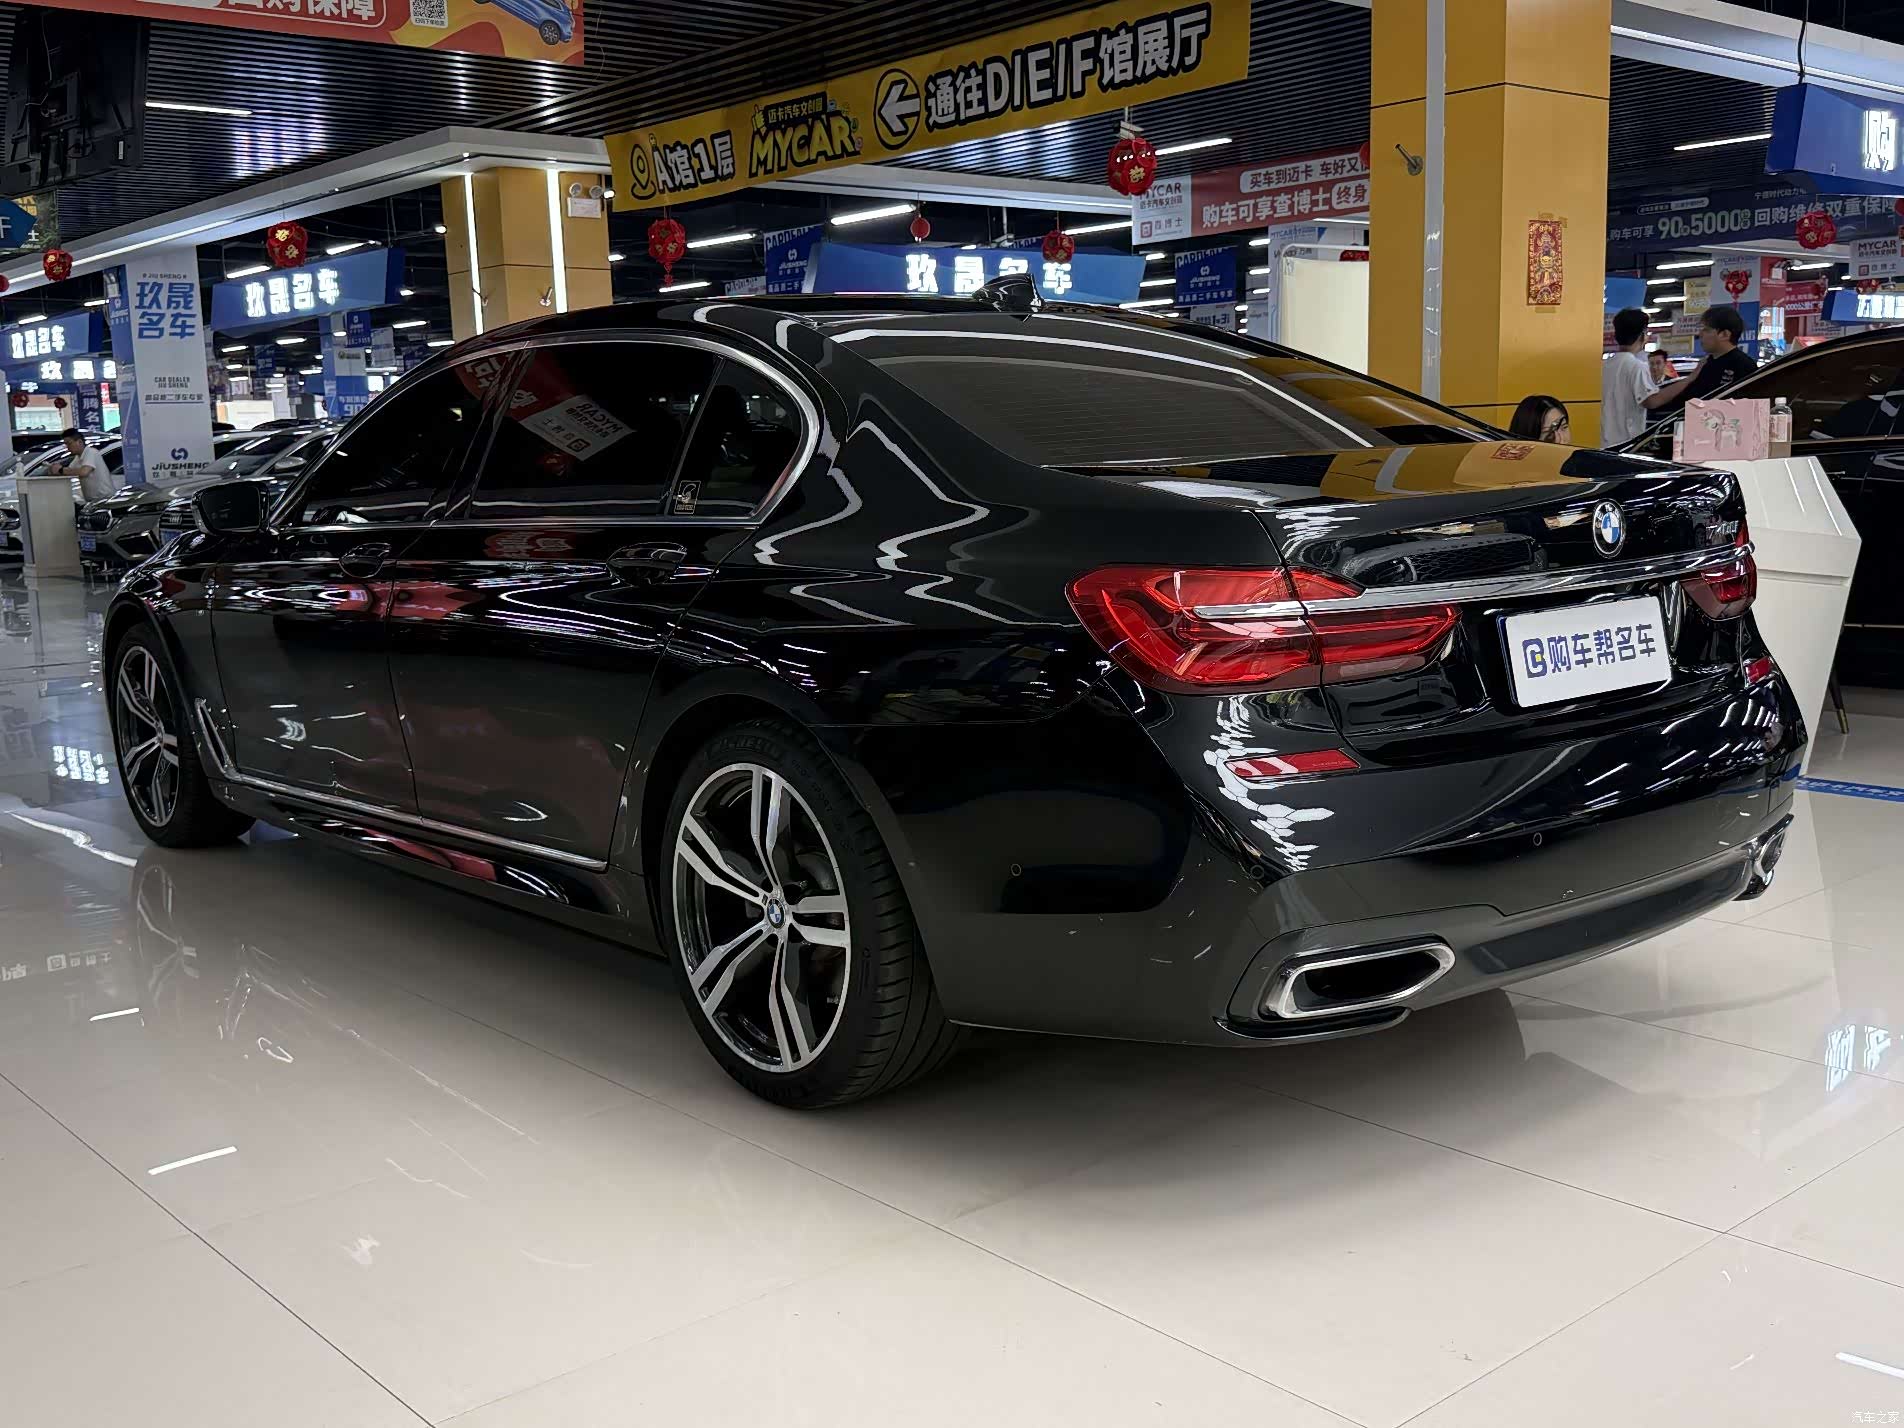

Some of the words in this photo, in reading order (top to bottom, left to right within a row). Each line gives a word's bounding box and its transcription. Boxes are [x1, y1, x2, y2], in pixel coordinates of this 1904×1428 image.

[654, 134, 736, 193] A馆1层
[752, 116, 857, 176] MYCAR
[1862, 110, 1897, 172] 购
[1249, 166, 1313, 190] 买车到迈卡
[1202, 187, 1331, 229] 购车可享查博士
[1336, 184, 1367, 205] 终身
[1858, 240, 1897, 251] MYCAR
[135, 281, 195, 310] 玖晟
[138, 311, 197, 340] 名车
[1546, 623, 1657, 674] 购车帮名车
